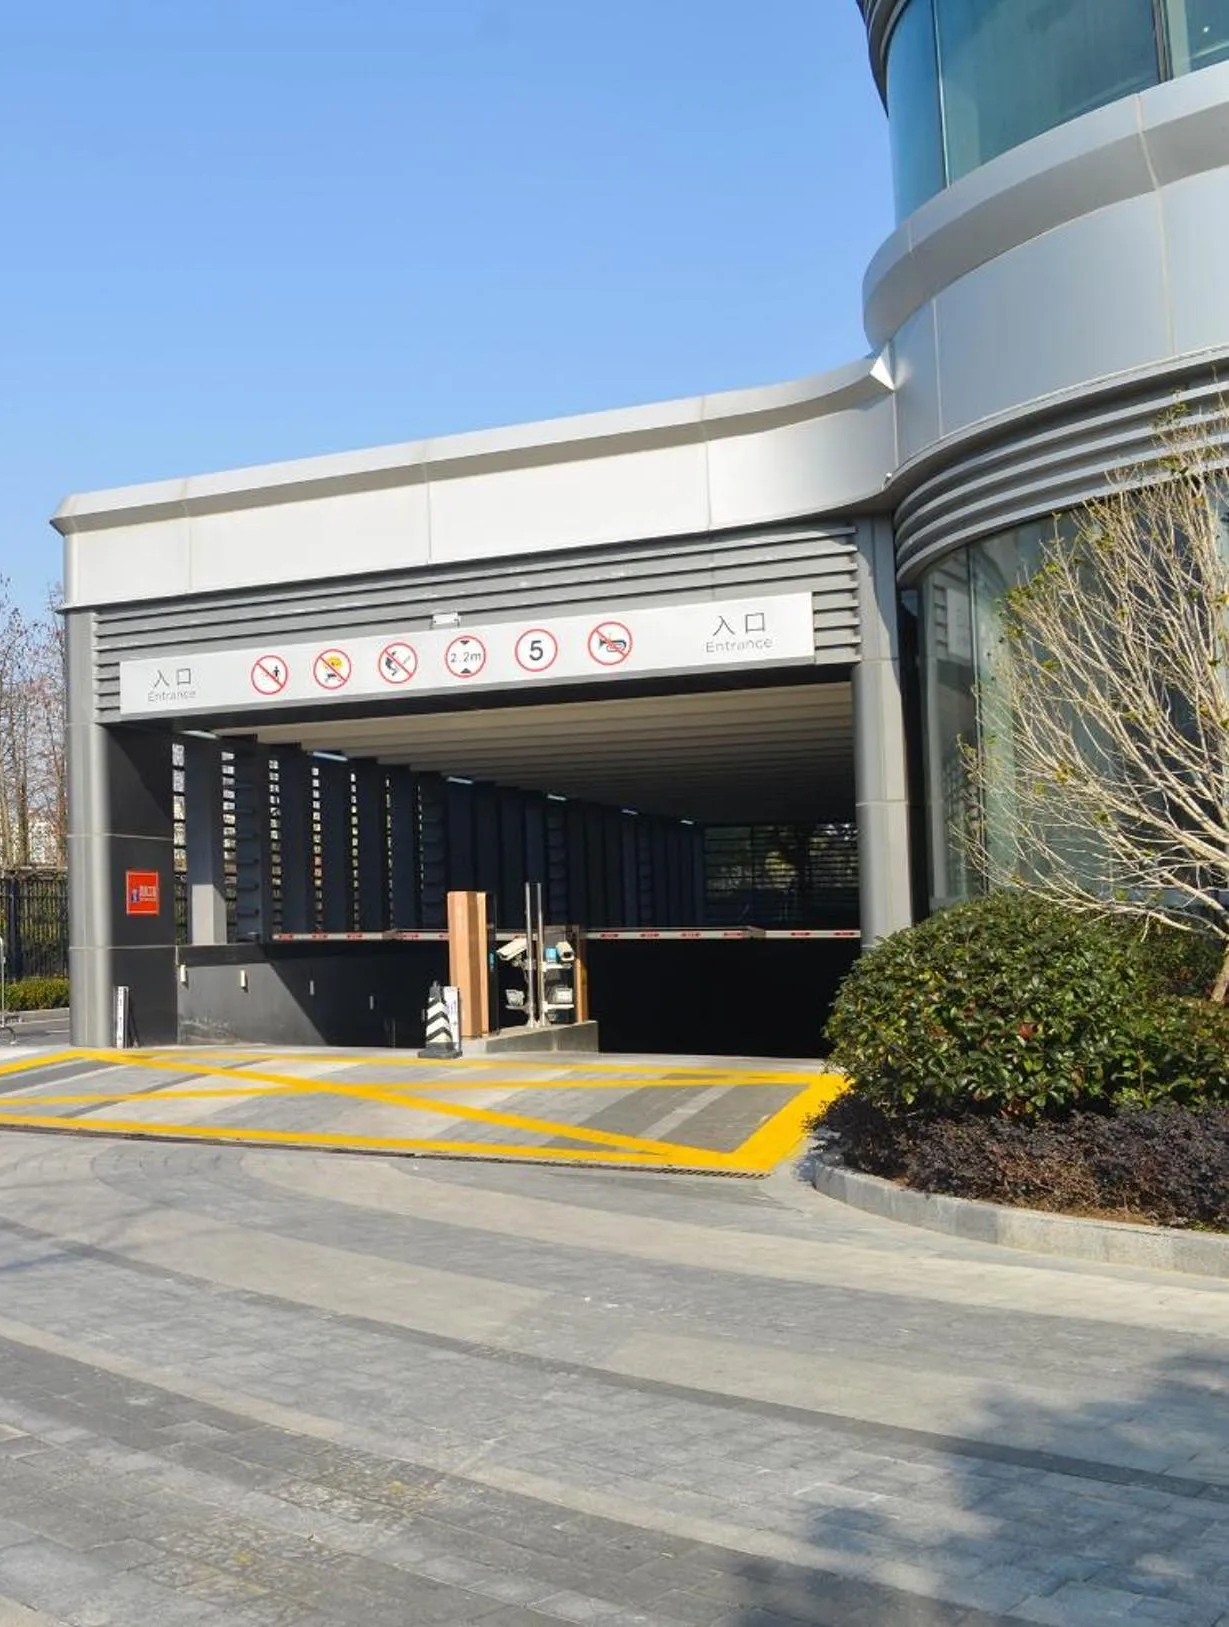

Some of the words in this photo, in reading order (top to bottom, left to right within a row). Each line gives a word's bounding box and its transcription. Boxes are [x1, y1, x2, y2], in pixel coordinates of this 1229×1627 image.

[712, 611, 765, 636] 入口
[529, 640, 544, 661] 5
[706, 638, 773, 653] Entrance
[450, 651, 482, 663] 2.2m
[154, 668, 192, 687] 入口
[147, 689, 196, 702] Entrance
